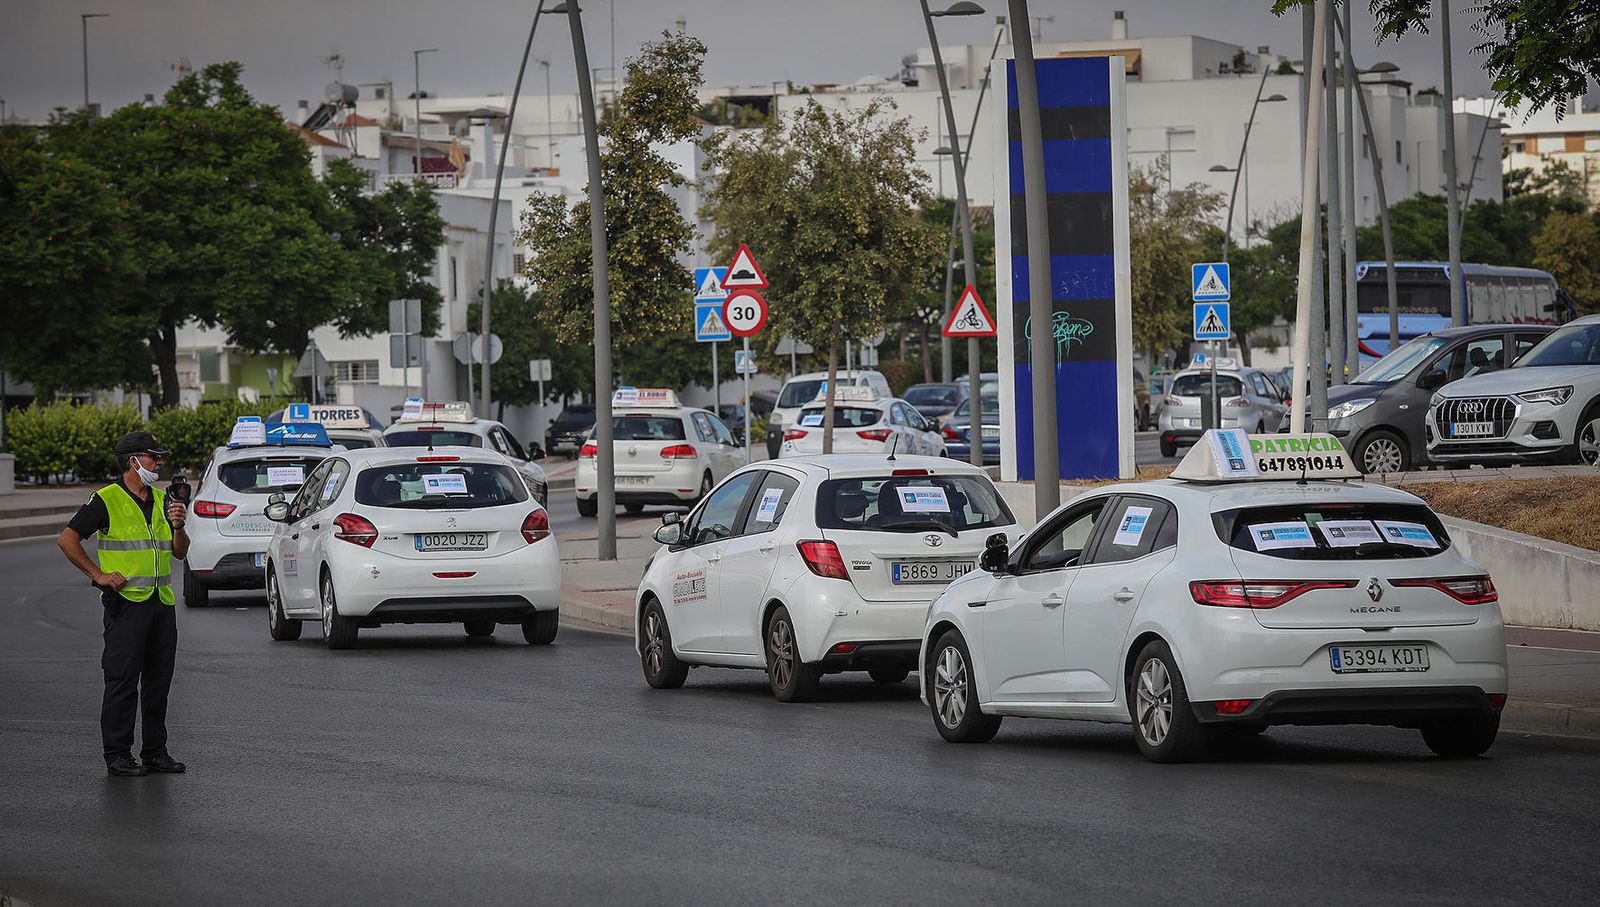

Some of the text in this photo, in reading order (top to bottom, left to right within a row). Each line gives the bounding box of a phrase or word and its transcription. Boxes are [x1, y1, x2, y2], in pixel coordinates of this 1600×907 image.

[733, 306, 755, 320] 30
[294, 406, 360, 420] L TORRES
[1456, 424, 1474, 434] 1301
[1250, 438, 1344, 453] PATRICIA
[1258, 456, 1344, 472] 647881044
[424, 534, 485, 546] 0020 JZZ
[901, 564, 938, 579] 5869
[946, 563, 972, 579] JHM
[1350, 605, 1401, 613] MEGANE
[1343, 649, 1387, 666] 5394
[1392, 648, 1423, 665] KDT
